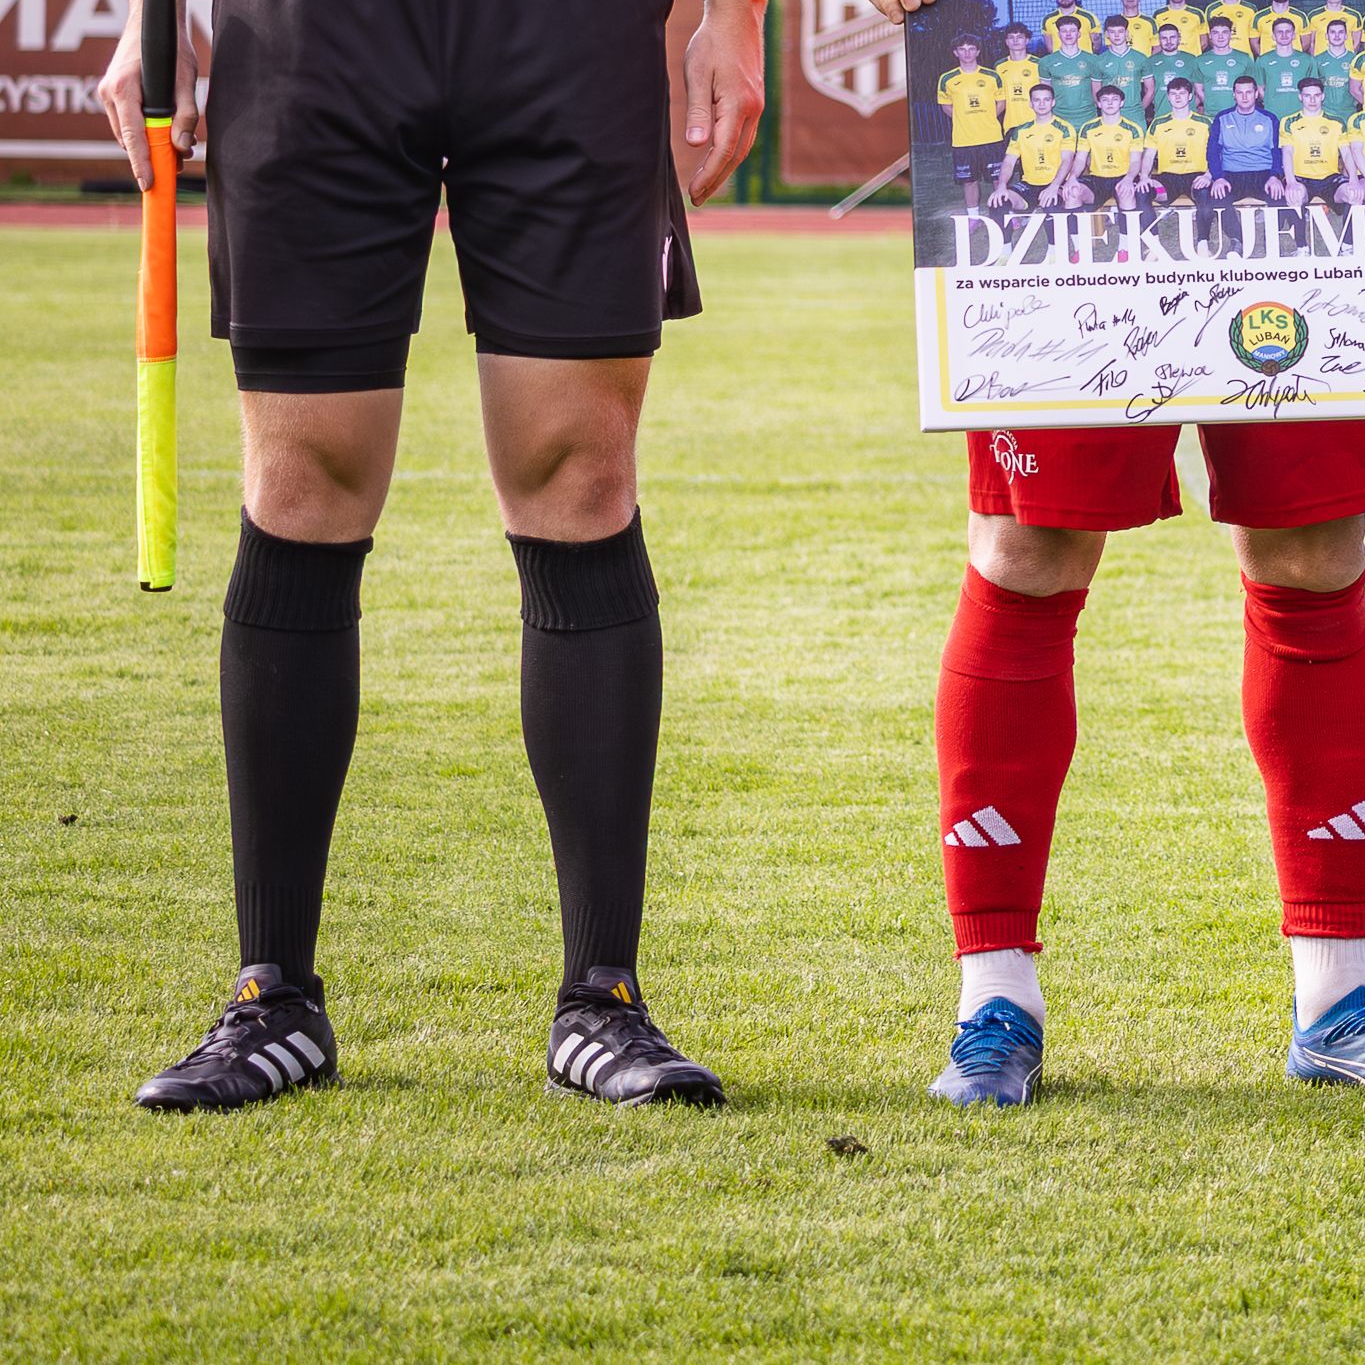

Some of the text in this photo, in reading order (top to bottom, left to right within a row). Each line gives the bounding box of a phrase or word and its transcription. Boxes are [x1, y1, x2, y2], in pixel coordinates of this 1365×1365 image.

[956, 279, 974, 289] za
[979, 275, 1050, 291] wsparcie
[1055, 271, 1140, 288] odbudowy
[1146, 268, 1215, 286] budynku
[1220, 265, 1309, 285] klubowego
[1314, 266, 1363, 280] Lubań
[1249, 309, 1288, 329] LKS
[1249, 331, 1290, 346] LUBAŃ
